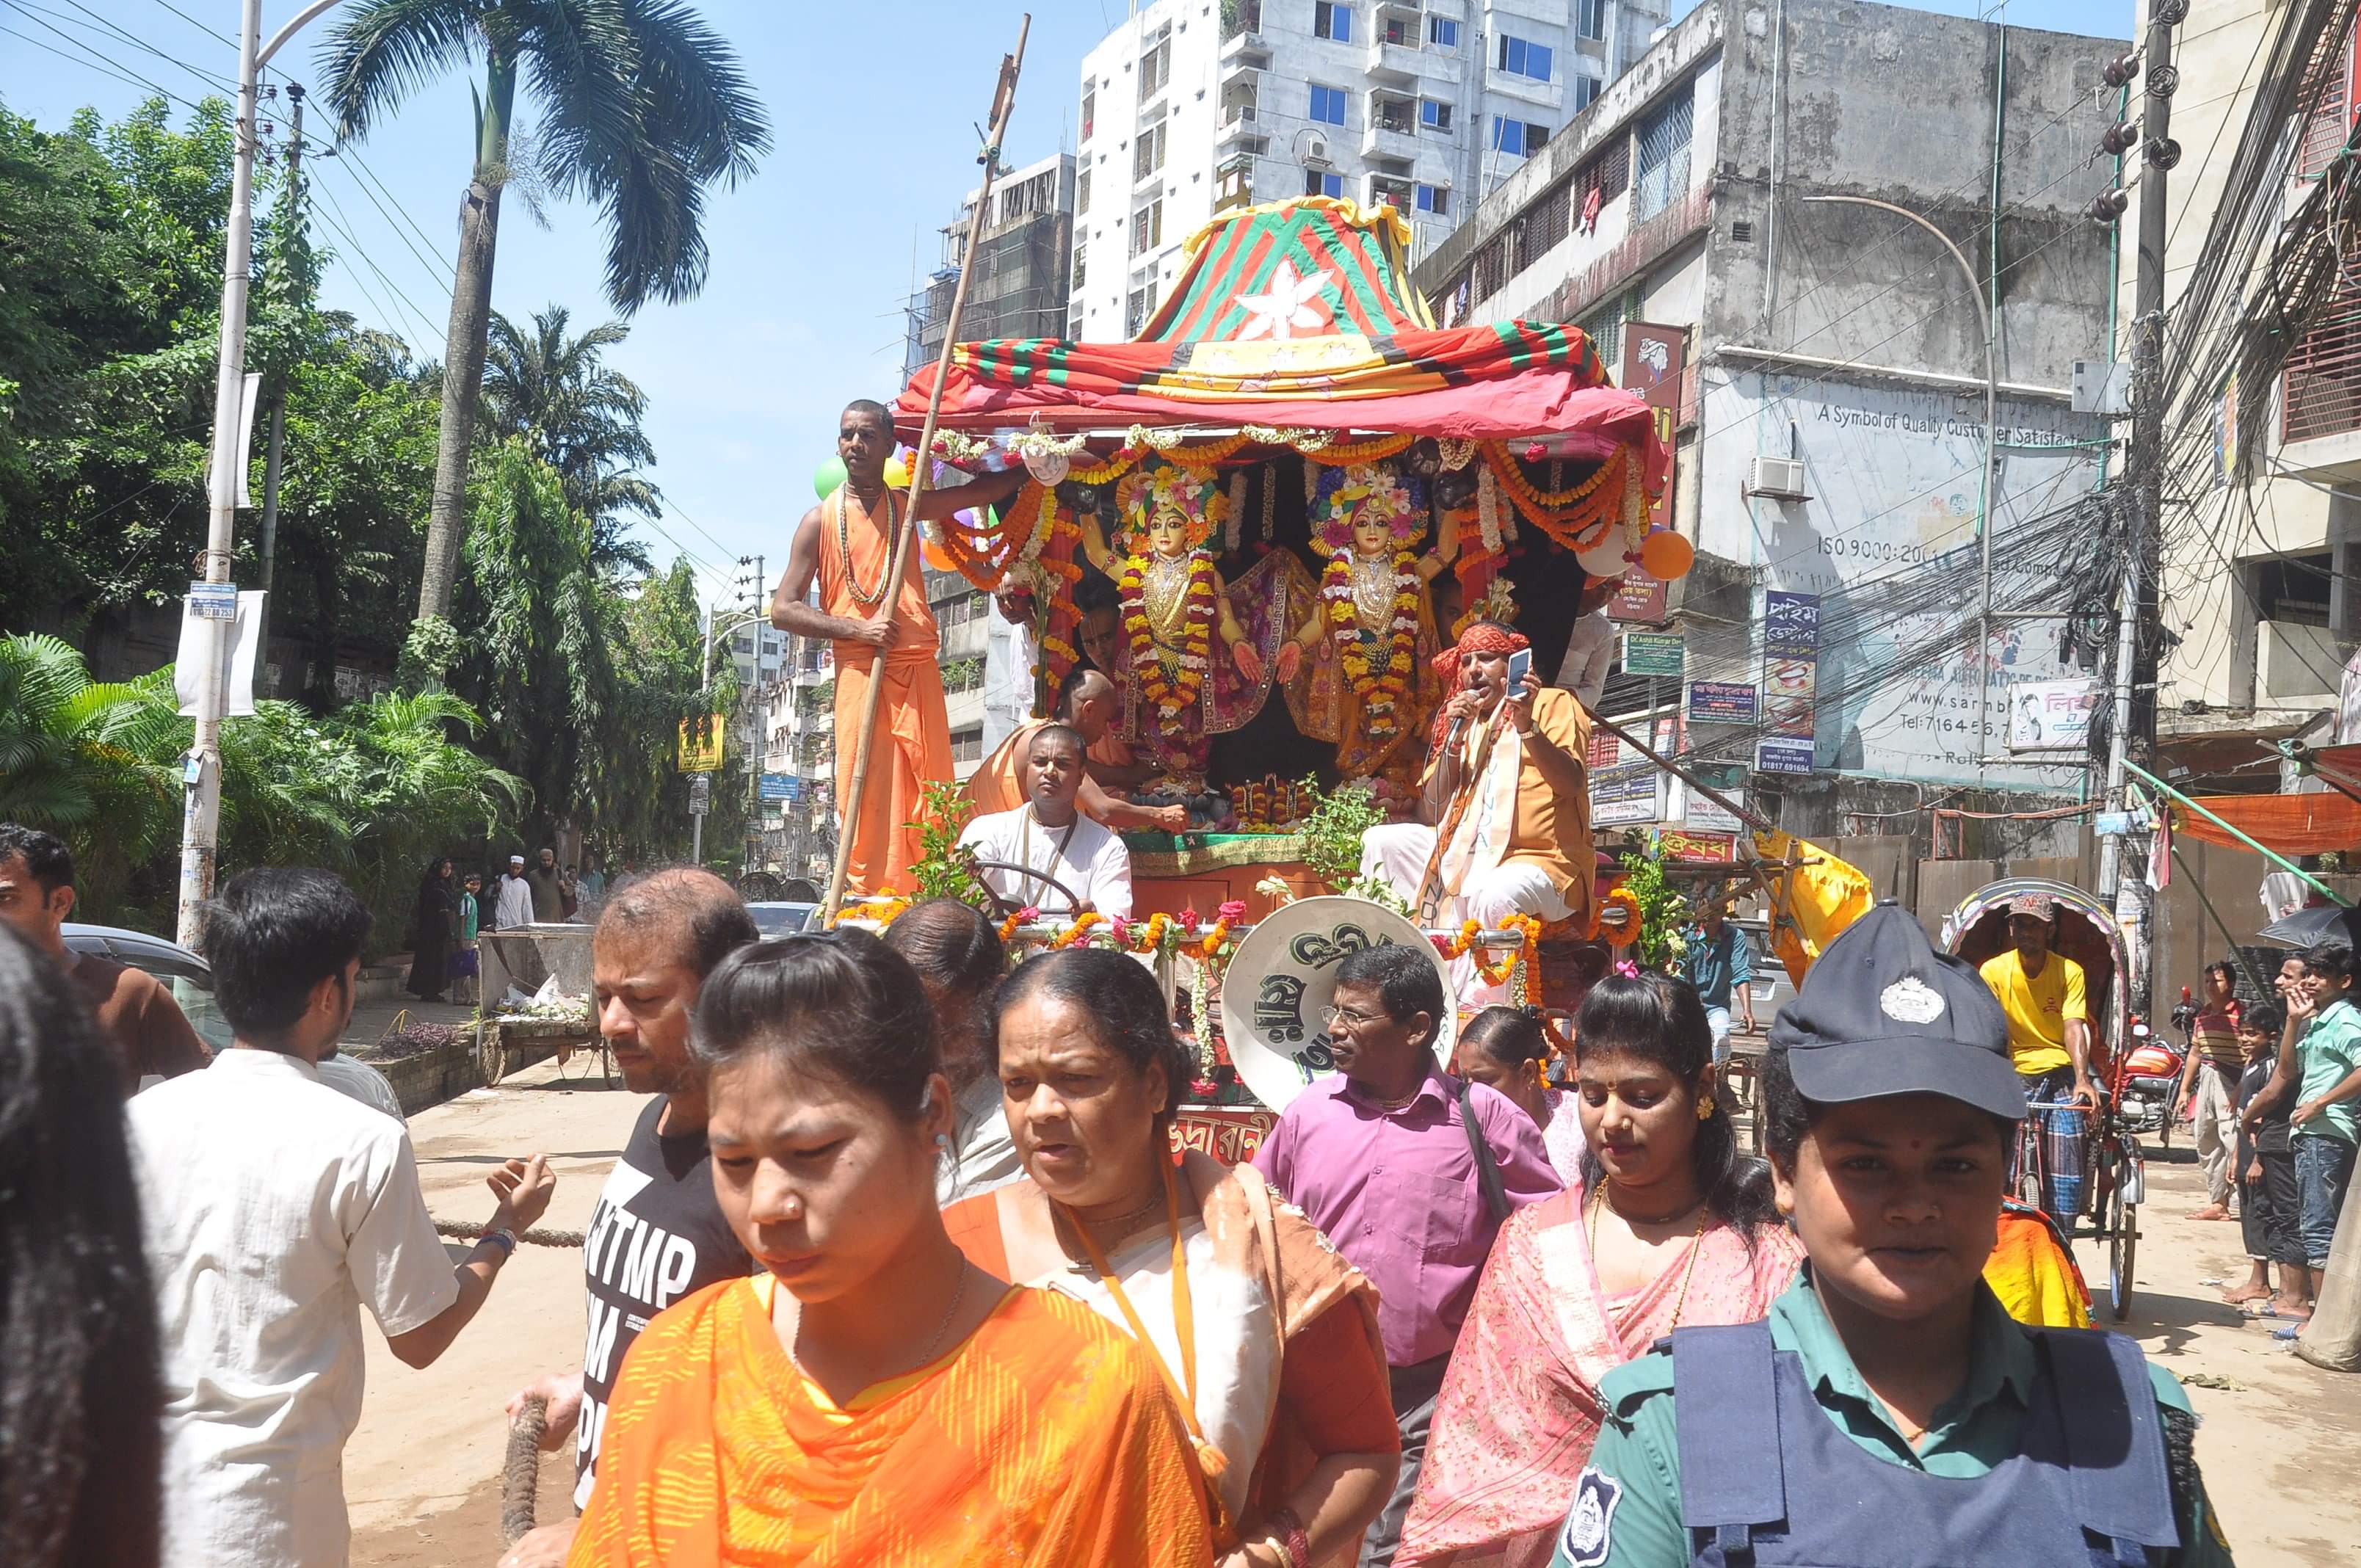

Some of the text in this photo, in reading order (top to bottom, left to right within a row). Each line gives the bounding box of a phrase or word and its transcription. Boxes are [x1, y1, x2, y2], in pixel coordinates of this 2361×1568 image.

[1818, 404, 1829, 422] A
[1834, 404, 1882, 428] Symbol
[1885, 412, 1898, 429] of
[1902, 413, 1943, 440] Quality
[1947, 418, 2012, 442] Custoer
[1818, 536, 1845, 556] ISO
[1762, 761, 1810, 773] 01817 691694
[1661, 832, 1730, 858] ঔষধ
